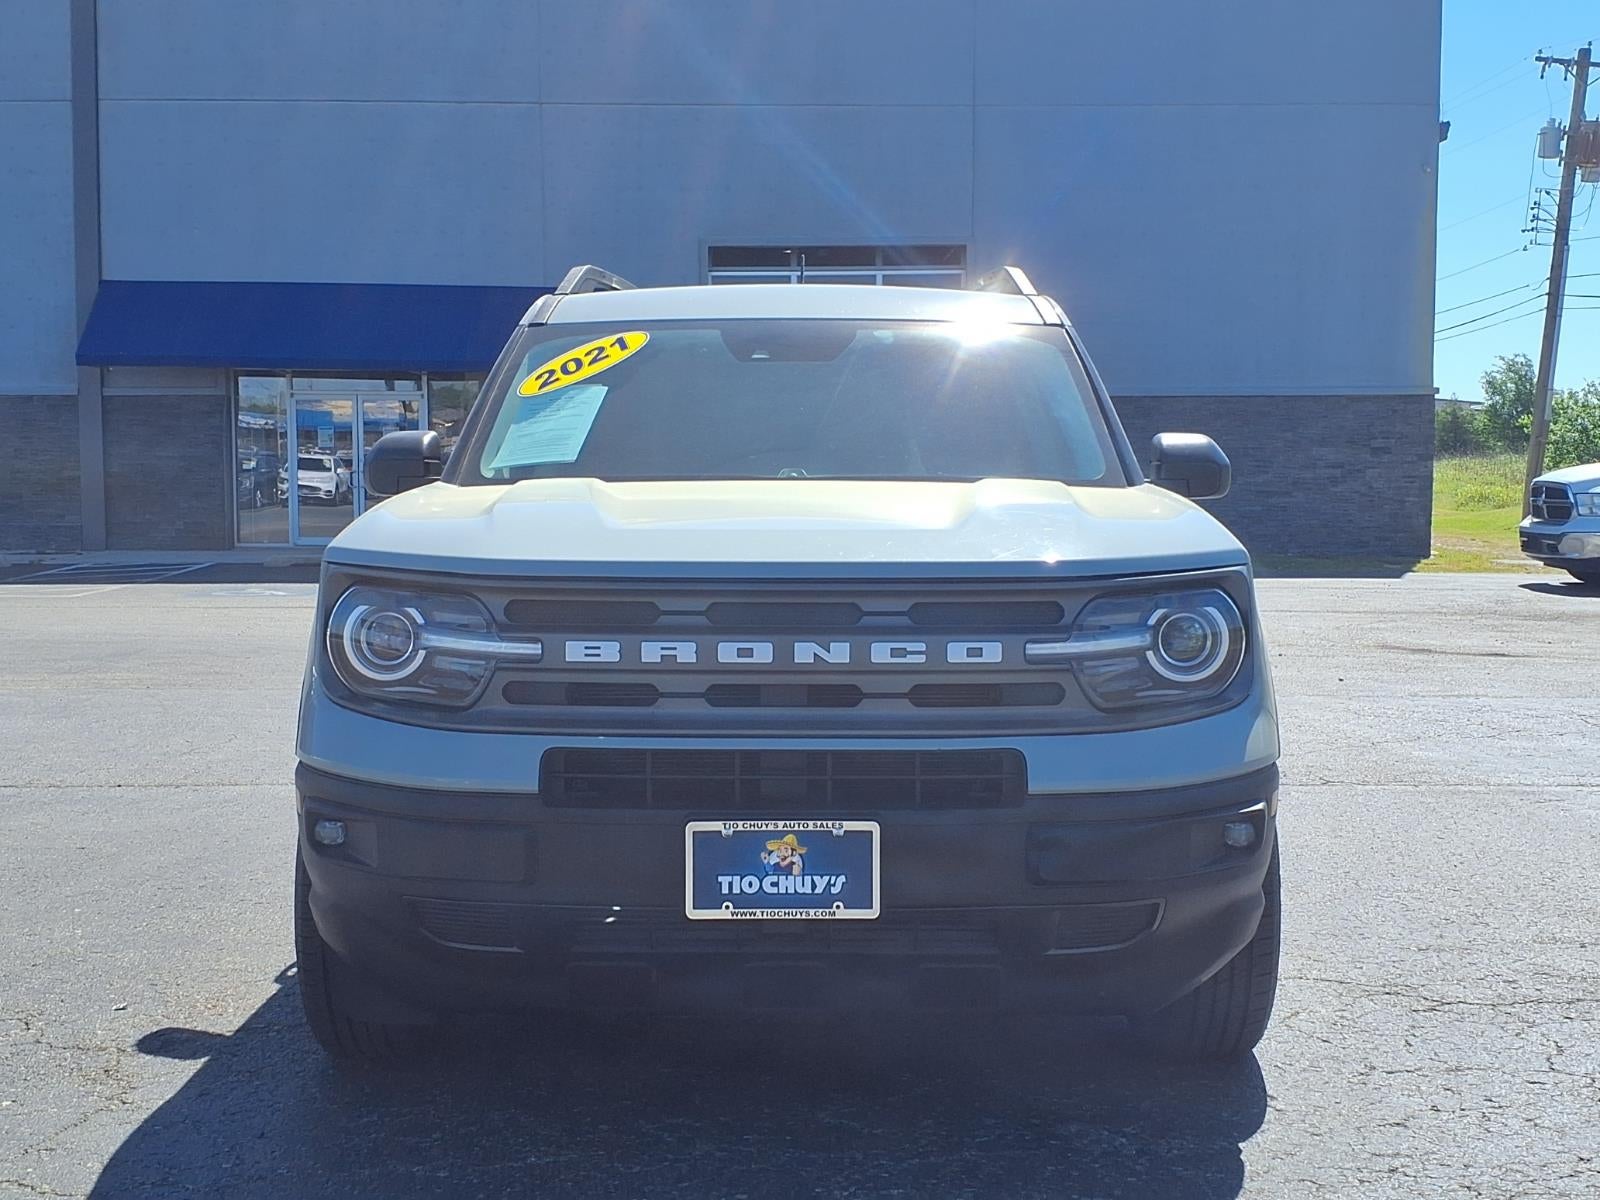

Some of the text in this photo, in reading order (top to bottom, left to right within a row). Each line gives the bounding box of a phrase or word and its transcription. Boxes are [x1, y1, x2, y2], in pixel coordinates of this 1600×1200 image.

[534, 335, 630, 392] 2021
[564, 641, 1003, 663] BRONCO
[722, 822, 844, 830] TIO CHUY'S AUTO SALES
[730, 910, 837, 918] WWW.TIOCHUYS.COM
